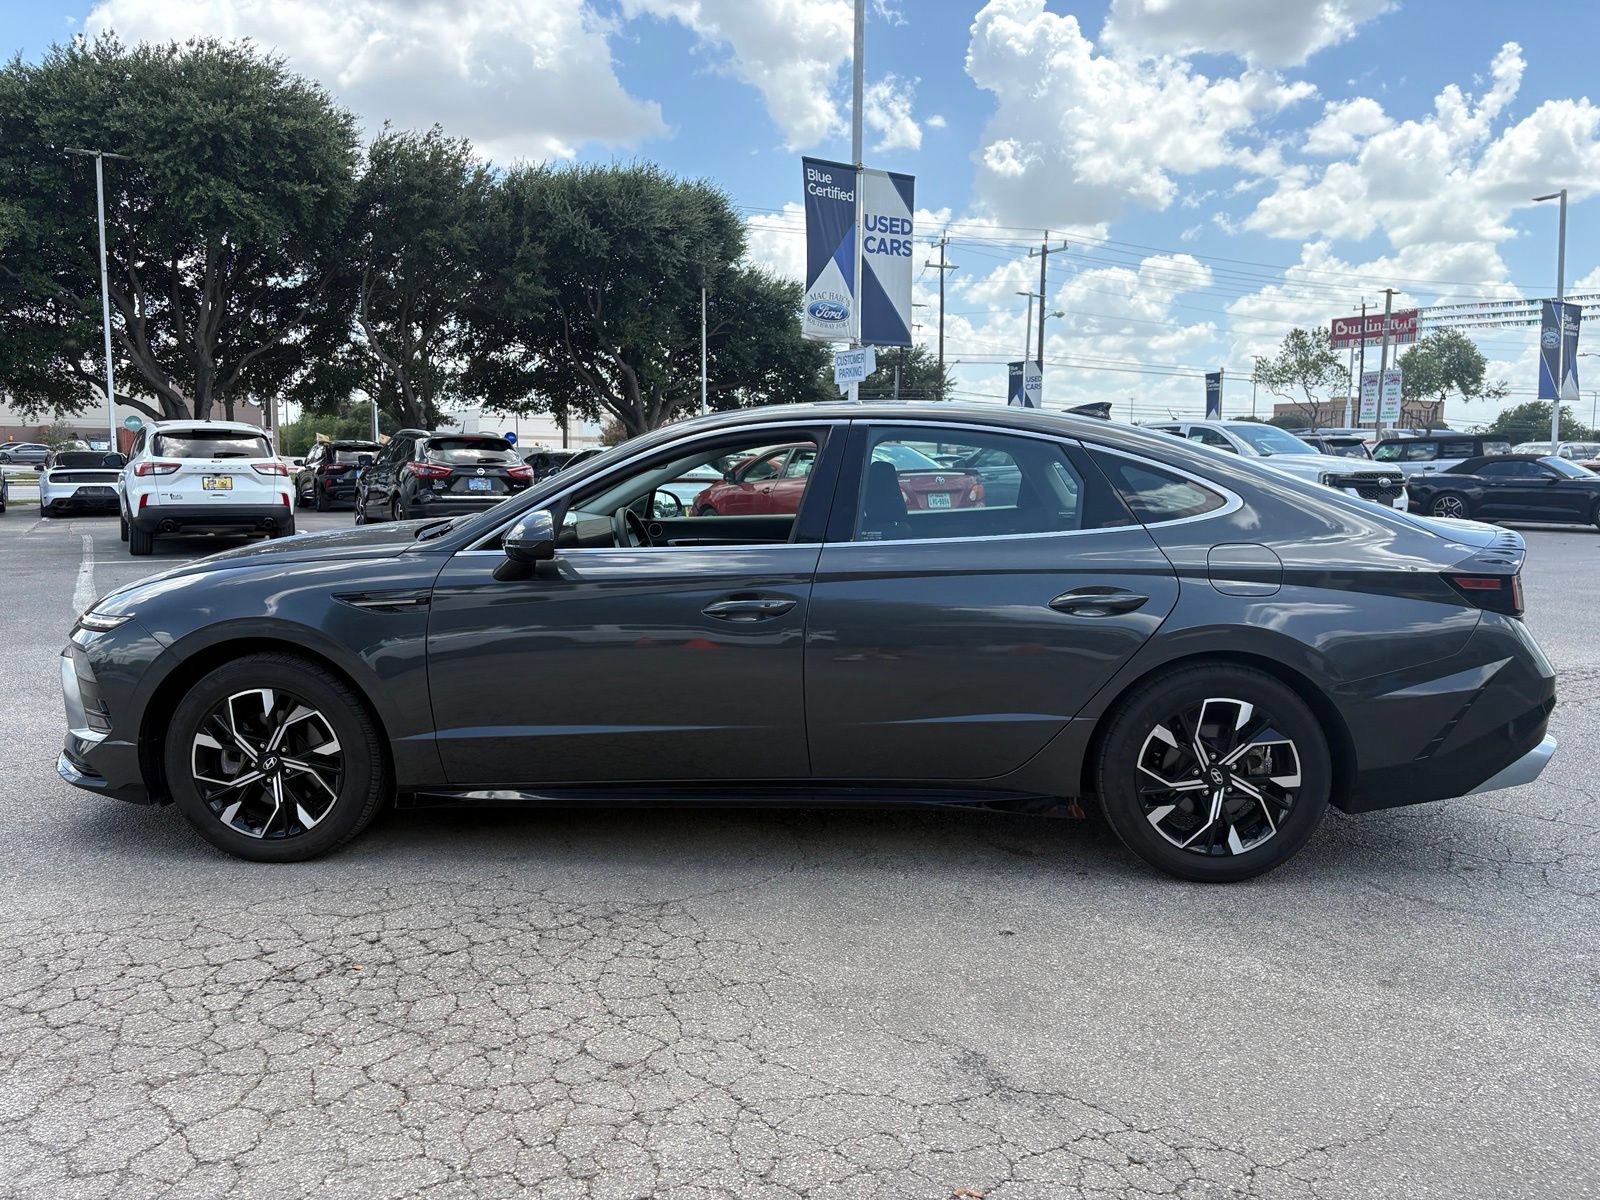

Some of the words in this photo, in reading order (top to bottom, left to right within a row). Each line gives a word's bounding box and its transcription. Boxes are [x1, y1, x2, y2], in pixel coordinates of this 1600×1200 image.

[807, 169, 832, 184] Blue
[808, 183, 854, 202] Certified
[864, 214, 913, 235] USED
[863, 236, 913, 257] CARS
[809, 291, 827, 301] MAC
[815, 302, 844, 319] Ford
[836, 353, 865, 366] CUSTOMER
[838, 366, 862, 378] PARKING
